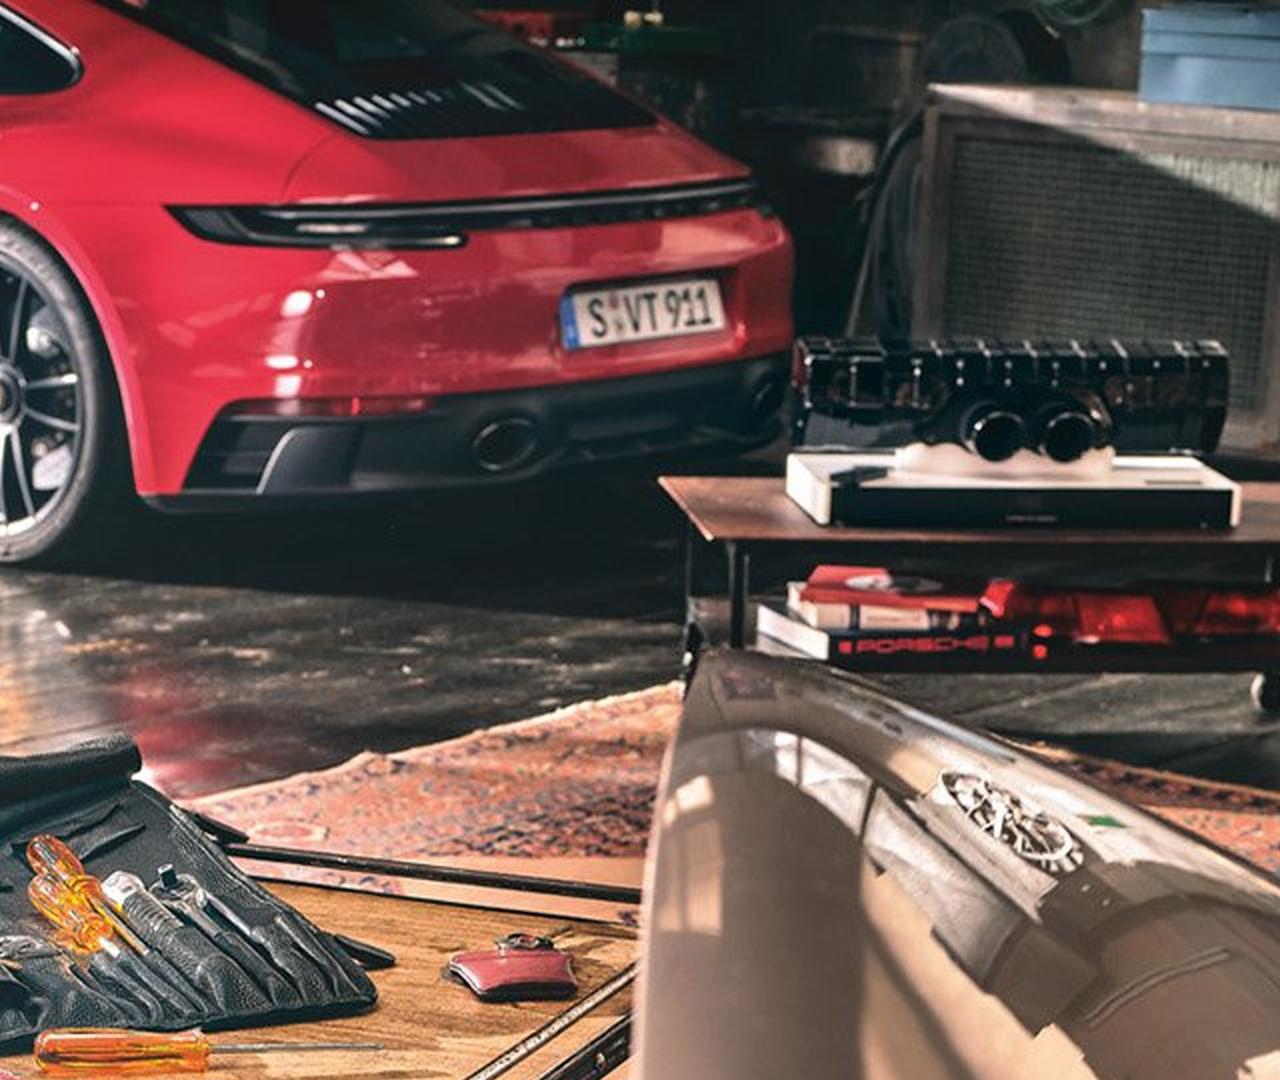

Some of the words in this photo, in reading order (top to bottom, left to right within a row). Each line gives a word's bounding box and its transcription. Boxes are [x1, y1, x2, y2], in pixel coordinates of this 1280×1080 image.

[587, 298, 608, 338] S
[624, 293, 658, 333] VT
[665, 287, 713, 328] 911
